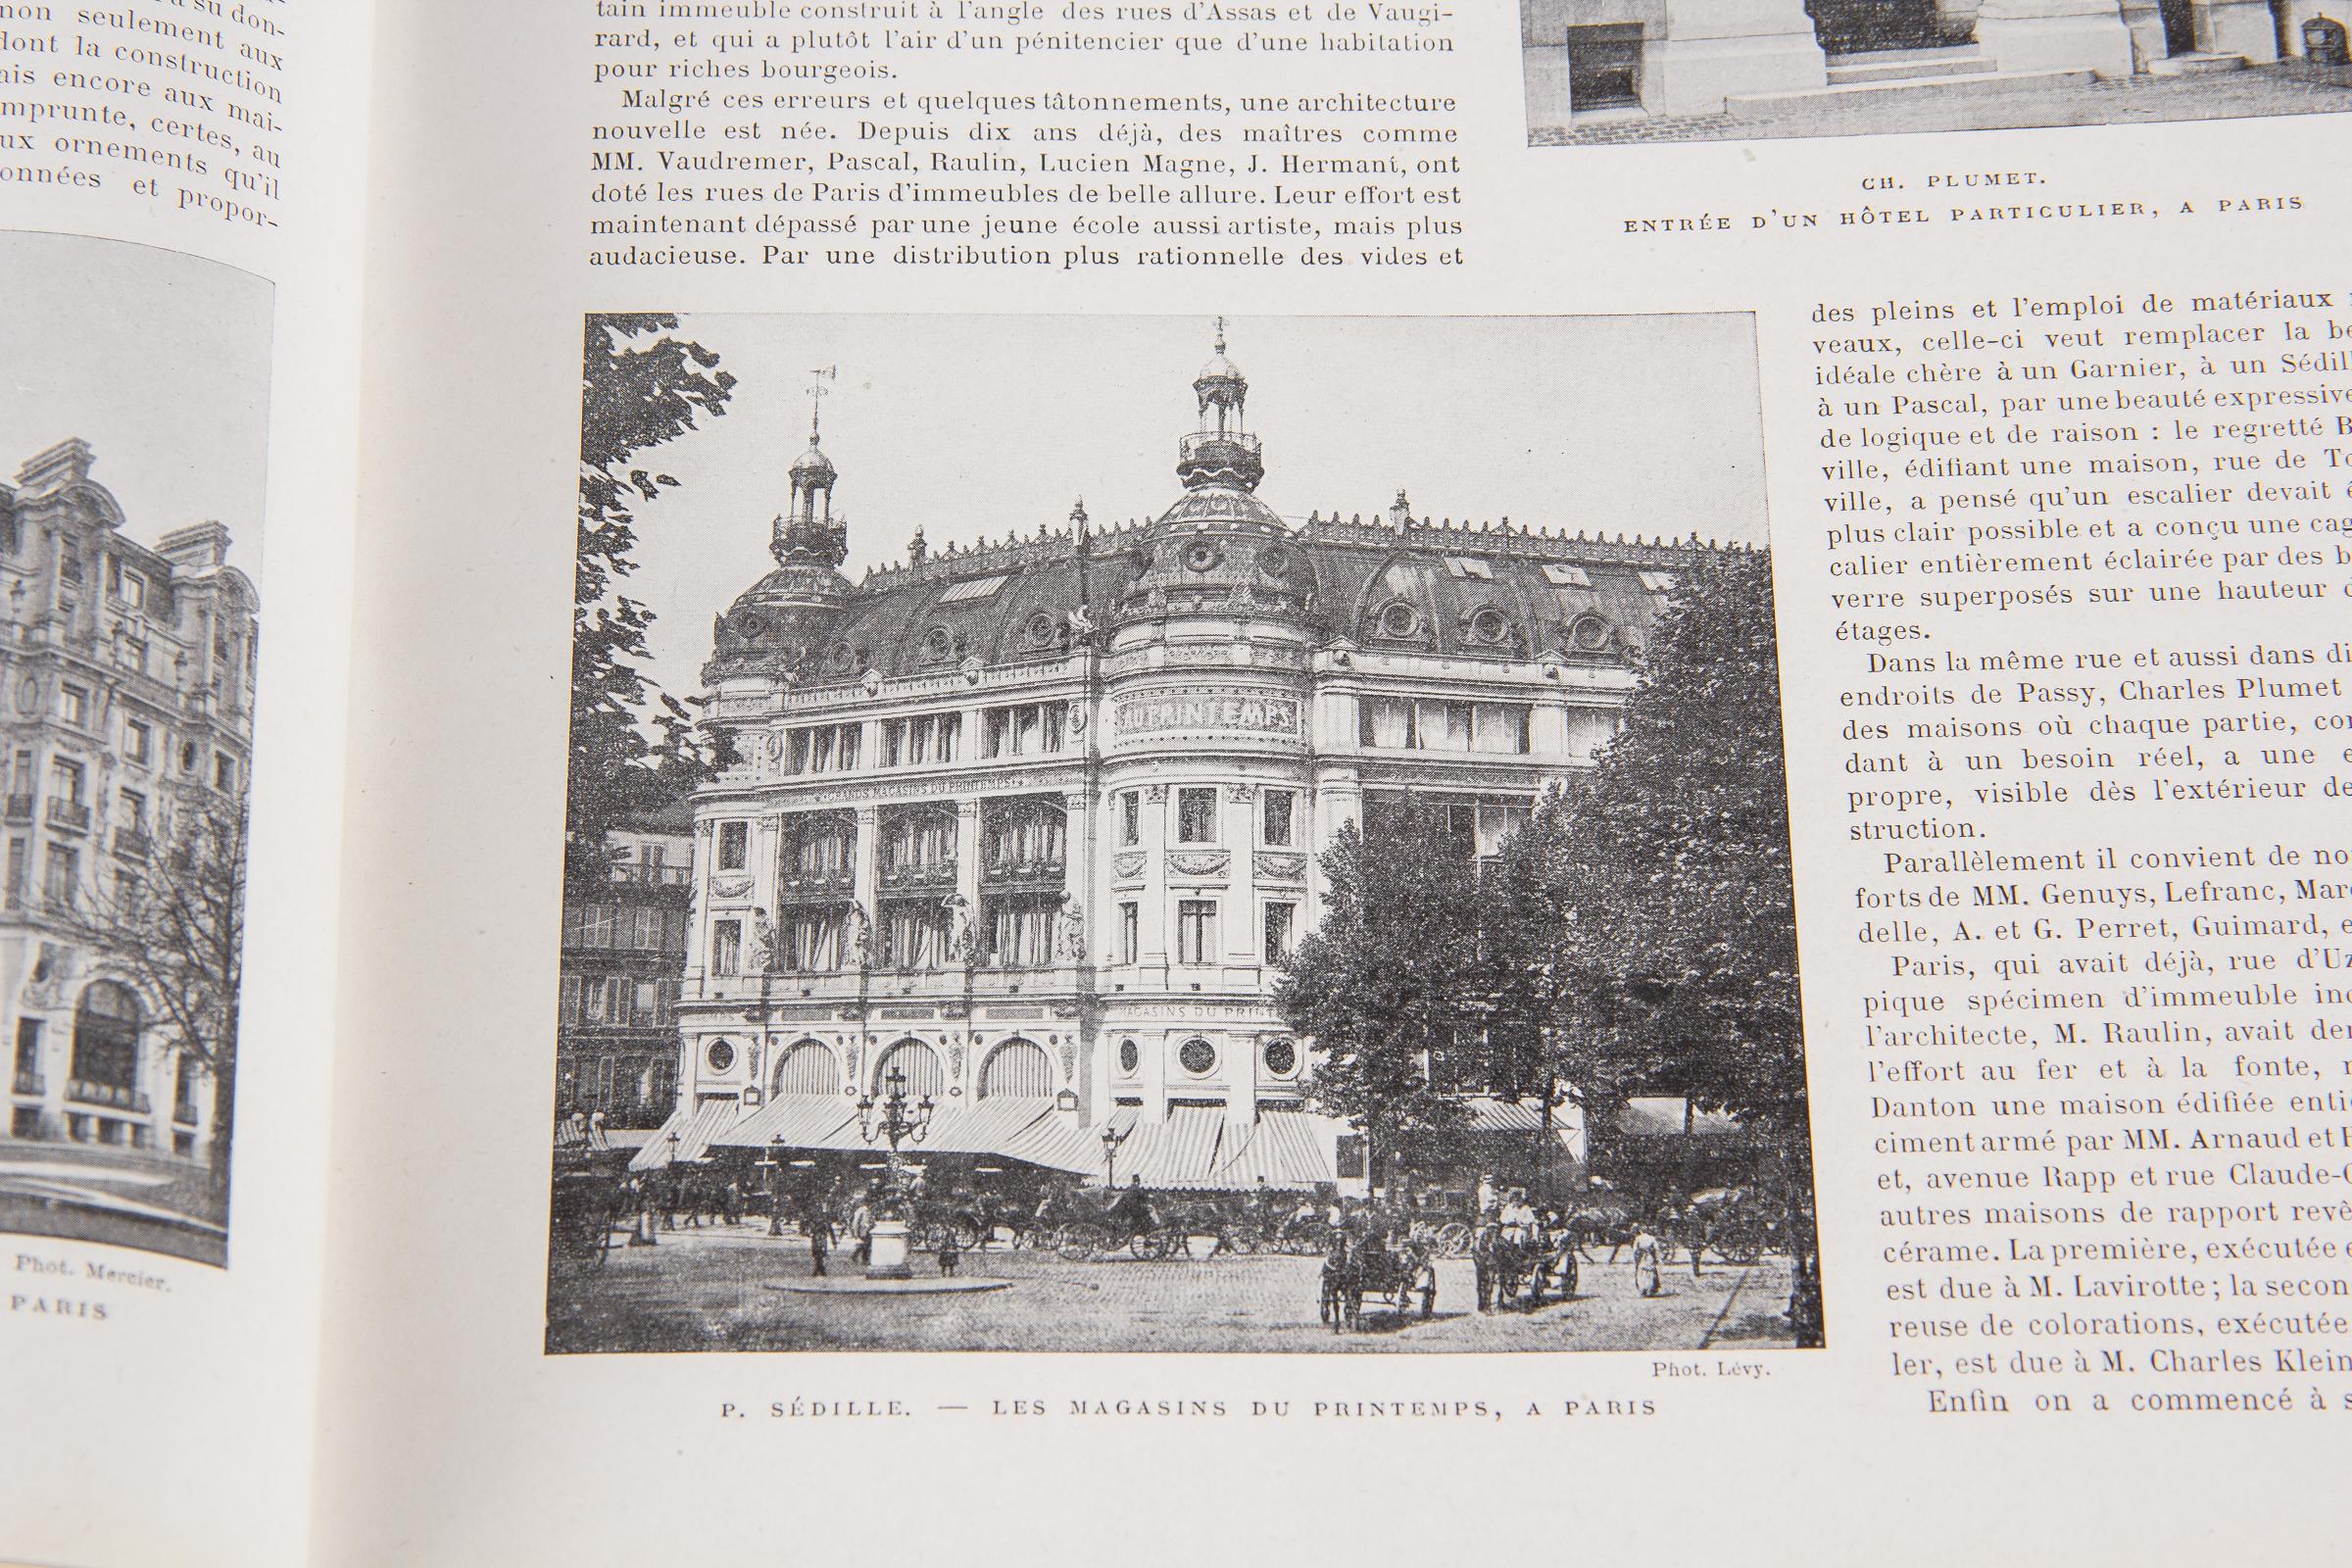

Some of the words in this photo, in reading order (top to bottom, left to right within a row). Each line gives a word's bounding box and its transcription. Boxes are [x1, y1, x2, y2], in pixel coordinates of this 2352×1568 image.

[231, 3, 285, 37] don-
[595, 0, 647, 18] tain
[659, 0, 791, 20] immeuble
[800, 0, 919, 20] construit
[929, 0, 944, 20] à
[957, 0, 1044, 26] l'angle
[1061, 1, 1104, 21] des
[1116, 7, 1172, 22] rues
[1183, 1, 1277, 22] d'Assas
[1288, 3, 1313, 22] et
[1327, 2, 1356, 22] de
[1367, 2, 1453, 27] Vaugi-
[77, 9, 224, 50] seulement
[239, 42, 283, 72] aux
[594, 28, 660, 52] rard,
[673, 30, 698, 48] et
[711, 28, 754, 54] qui
[765, 34, 780, 49] a
[791, 29, 870, 54] plutôt
[885, 29, 937, 49] l'air
[947, 29, 1004, 50] d'un
[1014, 30, 1164, 56] pénitencier
[1175, 36, 1223, 57] que
[1237, 31, 1308, 52] d'une
[1319, 31, 1454, 52] habitation
[74, 34, 101, 59] la
[115, 45, 282, 105] construction
[53, 72, 151, 97] encore
[164, 87, 215, 113] aux
[227, 103, 283, 132] mai-
[621, 88, 710, 115] Malgré
[722, 93, 763, 109] ces
[773, 94, 870, 110] erreurs
[883, 91, 907, 110] et
[917, 90, 1036, 116] quelques
[1042, 91, 1231, 117] tâtonnements,
[1240, 97, 1289, 112] une
[1298, 92, 1456, 113] architecture
[151, 117, 240, 157] certes,
[252, 144, 281, 170] au
[54, 137, 208, 175] ornements
[224, 168, 280, 201] qu'il
[590, 151, 643, 172] MM.
[657, 150, 814, 175] Vaudremer,
[826, 151, 918, 176] Pascal,
[929, 151, 1026, 177] Raulin,
[1039, 152, 1130, 172] Lucien
[1142, 154, 1235, 179] Magne,
[1247, 154, 1267, 173] J.
[1416, 155, 1460, 174] ont
[1861, 175, 1904, 191] CH.
[1927, 172, 2046, 188] PLUMET.
[132, 177, 159, 197] et
[177, 187, 278, 227] propor-
[1623, 212, 1731, 233] ENTRÉE
[1750, 208, 1818, 229] D'UN
[1839, 205, 1930, 225] HÔTEL
[1949, 202, 2158, 221] PARTICULIER,
[2179, 201, 2195, 214] A
[2218, 196, 2303, 213] PARIS
[590, 214, 747, 235] maintenant
[755, 213, 858, 240] dépassé
[870, 219, 916, 240] par
[920, 219, 970, 234] une
[980, 214, 1058, 240] jeune
[1072, 215, 1140, 234] école
[1152, 215, 1220, 235] aussi
[1228, 215, 1321, 241] artiste,
[1333, 216, 1396, 235] mais
[1405, 215, 1463, 241] plus
[1811, 303, 1855, 323] des
[1871, 299, 1955, 327] pleins
[1972, 299, 1998, 318] et
[2012, 294, 2125, 321] l'emploi
[2141, 293, 2174, 314] de
[2190, 288, 2334, 312] matériaux
[1818, 397, 1834, 417] à
[1842, 401, 1881, 416] un
[1890, 392, 1987, 418] Pascal,
[2000, 397, 2046, 418] par
[2056, 395, 2109, 412] une
[2114, 388, 2206, 410] beauté
[1830, 555, 1908, 577] calier
[1920, 552, 2093, 574] entièrement
[2104, 548, 2214, 570] éclairée
[2221, 552, 2269, 573] par
[2277, 545, 2324, 566] des
[1839, 684, 1955, 708] endroits
[1970, 683, 2002, 705] de
[2016, 682, 2106, 709] Passy,
[2119, 678, 2226, 701] Charles
[2235, 676, 2342, 699] Plumet
[1148, 701, 1290, 727] PRINTEMPS
[1846, 789, 1952, 813] propre,
[1973, 780, 2069, 805] visible
[2089, 780, 2136, 802] dès
[2152, 777, 2307, 801] l'extérieur
[1849, 816, 1986, 841] struction.
[1858, 920, 1938, 948] delle,
[1952, 920, 1982, 942] A.
[1994, 920, 2021, 941] et
[2034, 917, 2062, 940] G.
[2075, 917, 2179, 943] Perret,
[2191, 912, 2328, 940] Guimard,
[1194, 1005, 1216, 1018] DU
[1868, 1059, 1966, 1083] l'effort
[1981, 1065, 2016, 1081] au
[2037, 1057, 2078, 1080] fer
[2099, 1058, 2128, 1080] et
[2146, 1055, 2165, 1079] à
[2180, 1055, 2208, 1078] la
[2233, 1054, 2321, 1081] fonte,
[1880, 1205, 1972, 1227] autres
[1984, 1200, 2105, 1224] maisons
[2120, 1200, 2154, 1224] de
[2167, 1200, 2279, 1229] rapport
[15, 1252, 76, 1277] Phot.
[85, 1262, 173, 1293] Mercier.
[11, 1294, 109, 1322] PARIS
[1888, 1319, 1968, 1339] reuse
[1980, 1312, 2014, 1337] de
[2028, 1310, 2204, 1338] colorations,
[2217, 1311, 2349, 1335] exécutée
[1651, 1361, 1707, 1378] Phot.
[1717, 1360, 1771, 1380] Lévy.
[721, 1402, 746, 1419] P.
[770, 1395, 910, 1418] SÉDILLE.
[993, 1399, 1046, 1416] LES
[1070, 1398, 1226, 1417] MAGASINS
[1251, 1400, 1290, 1417] DU
[1313, 1400, 1501, 1422] PRINTEMPS,
[1526, 1401, 1542, 1416] A
[1564, 1399, 1655, 1416] PARIS
